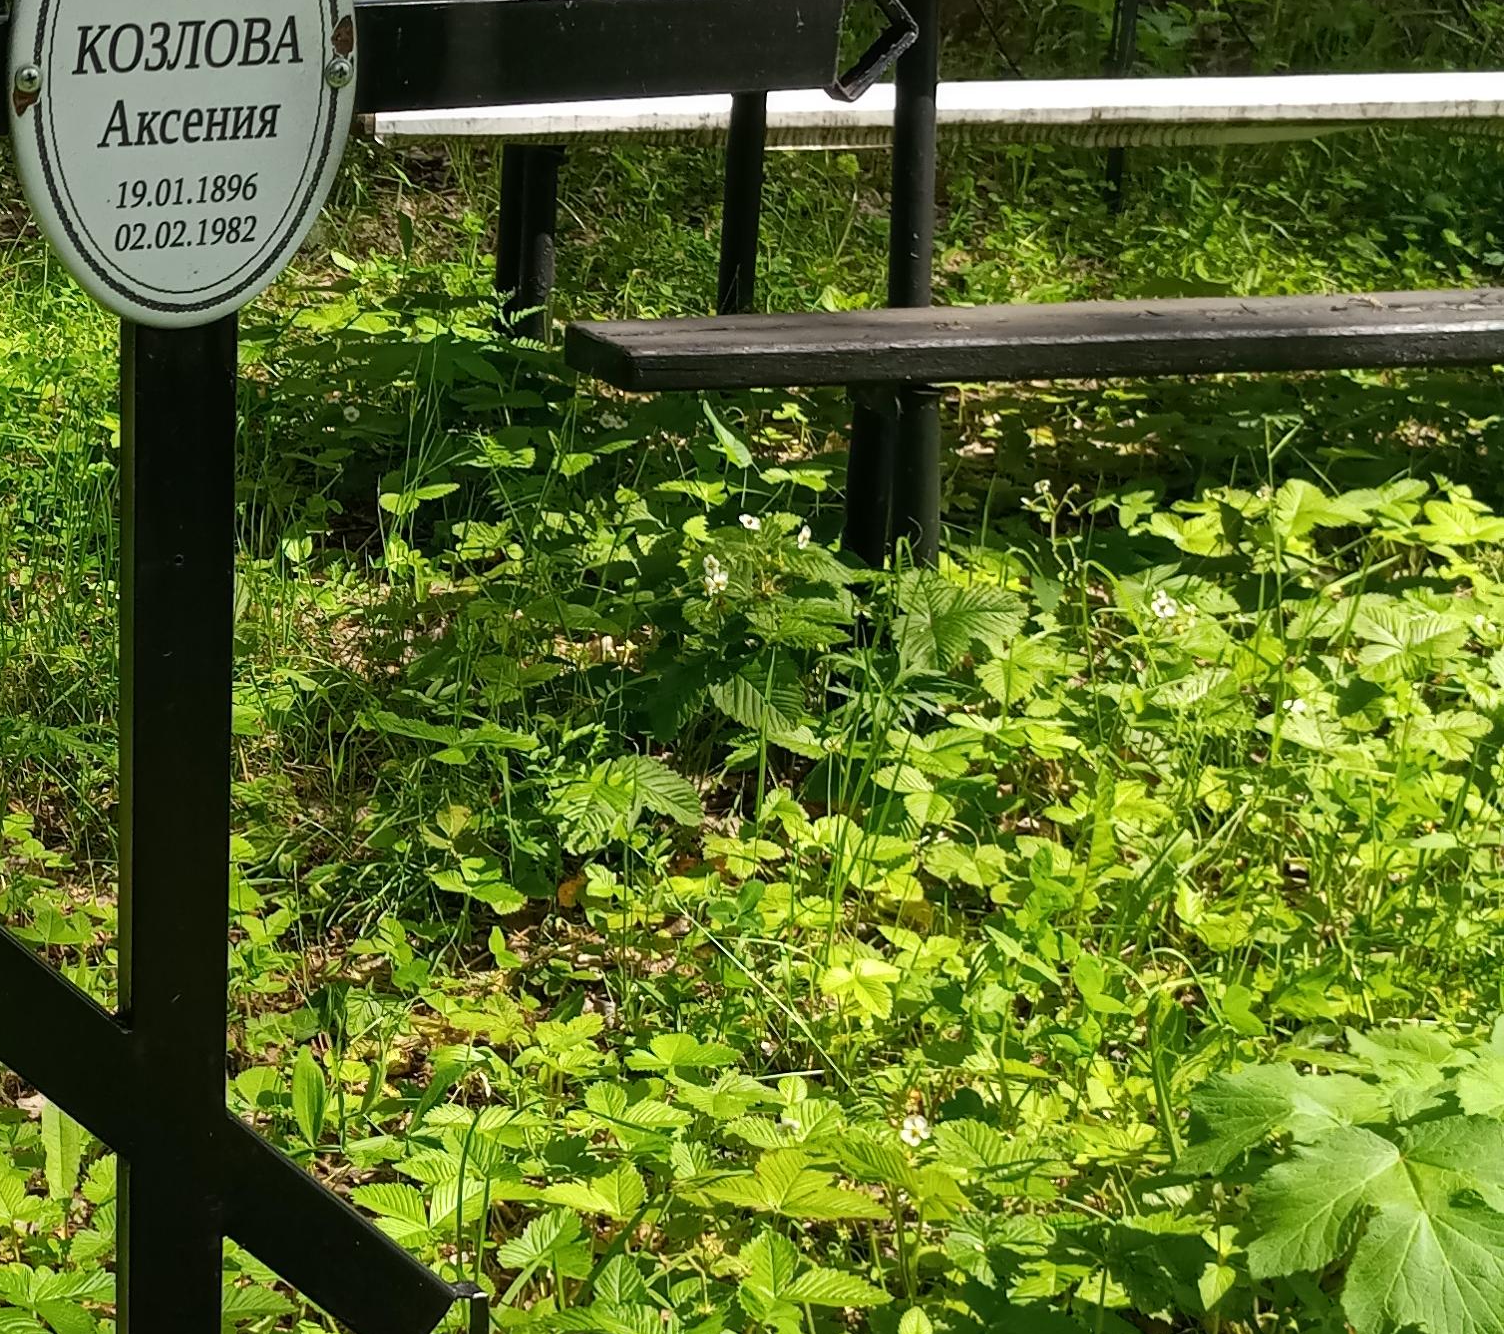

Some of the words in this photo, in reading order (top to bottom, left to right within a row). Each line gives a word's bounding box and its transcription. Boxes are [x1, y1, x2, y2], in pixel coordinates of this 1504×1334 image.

[72, 14, 303, 75] КОЗЛОВА
[97, 99, 281, 148] Аксения
[115, 172, 258, 209] 19.01.1896
[114, 215, 257, 251] 02.02.1982
